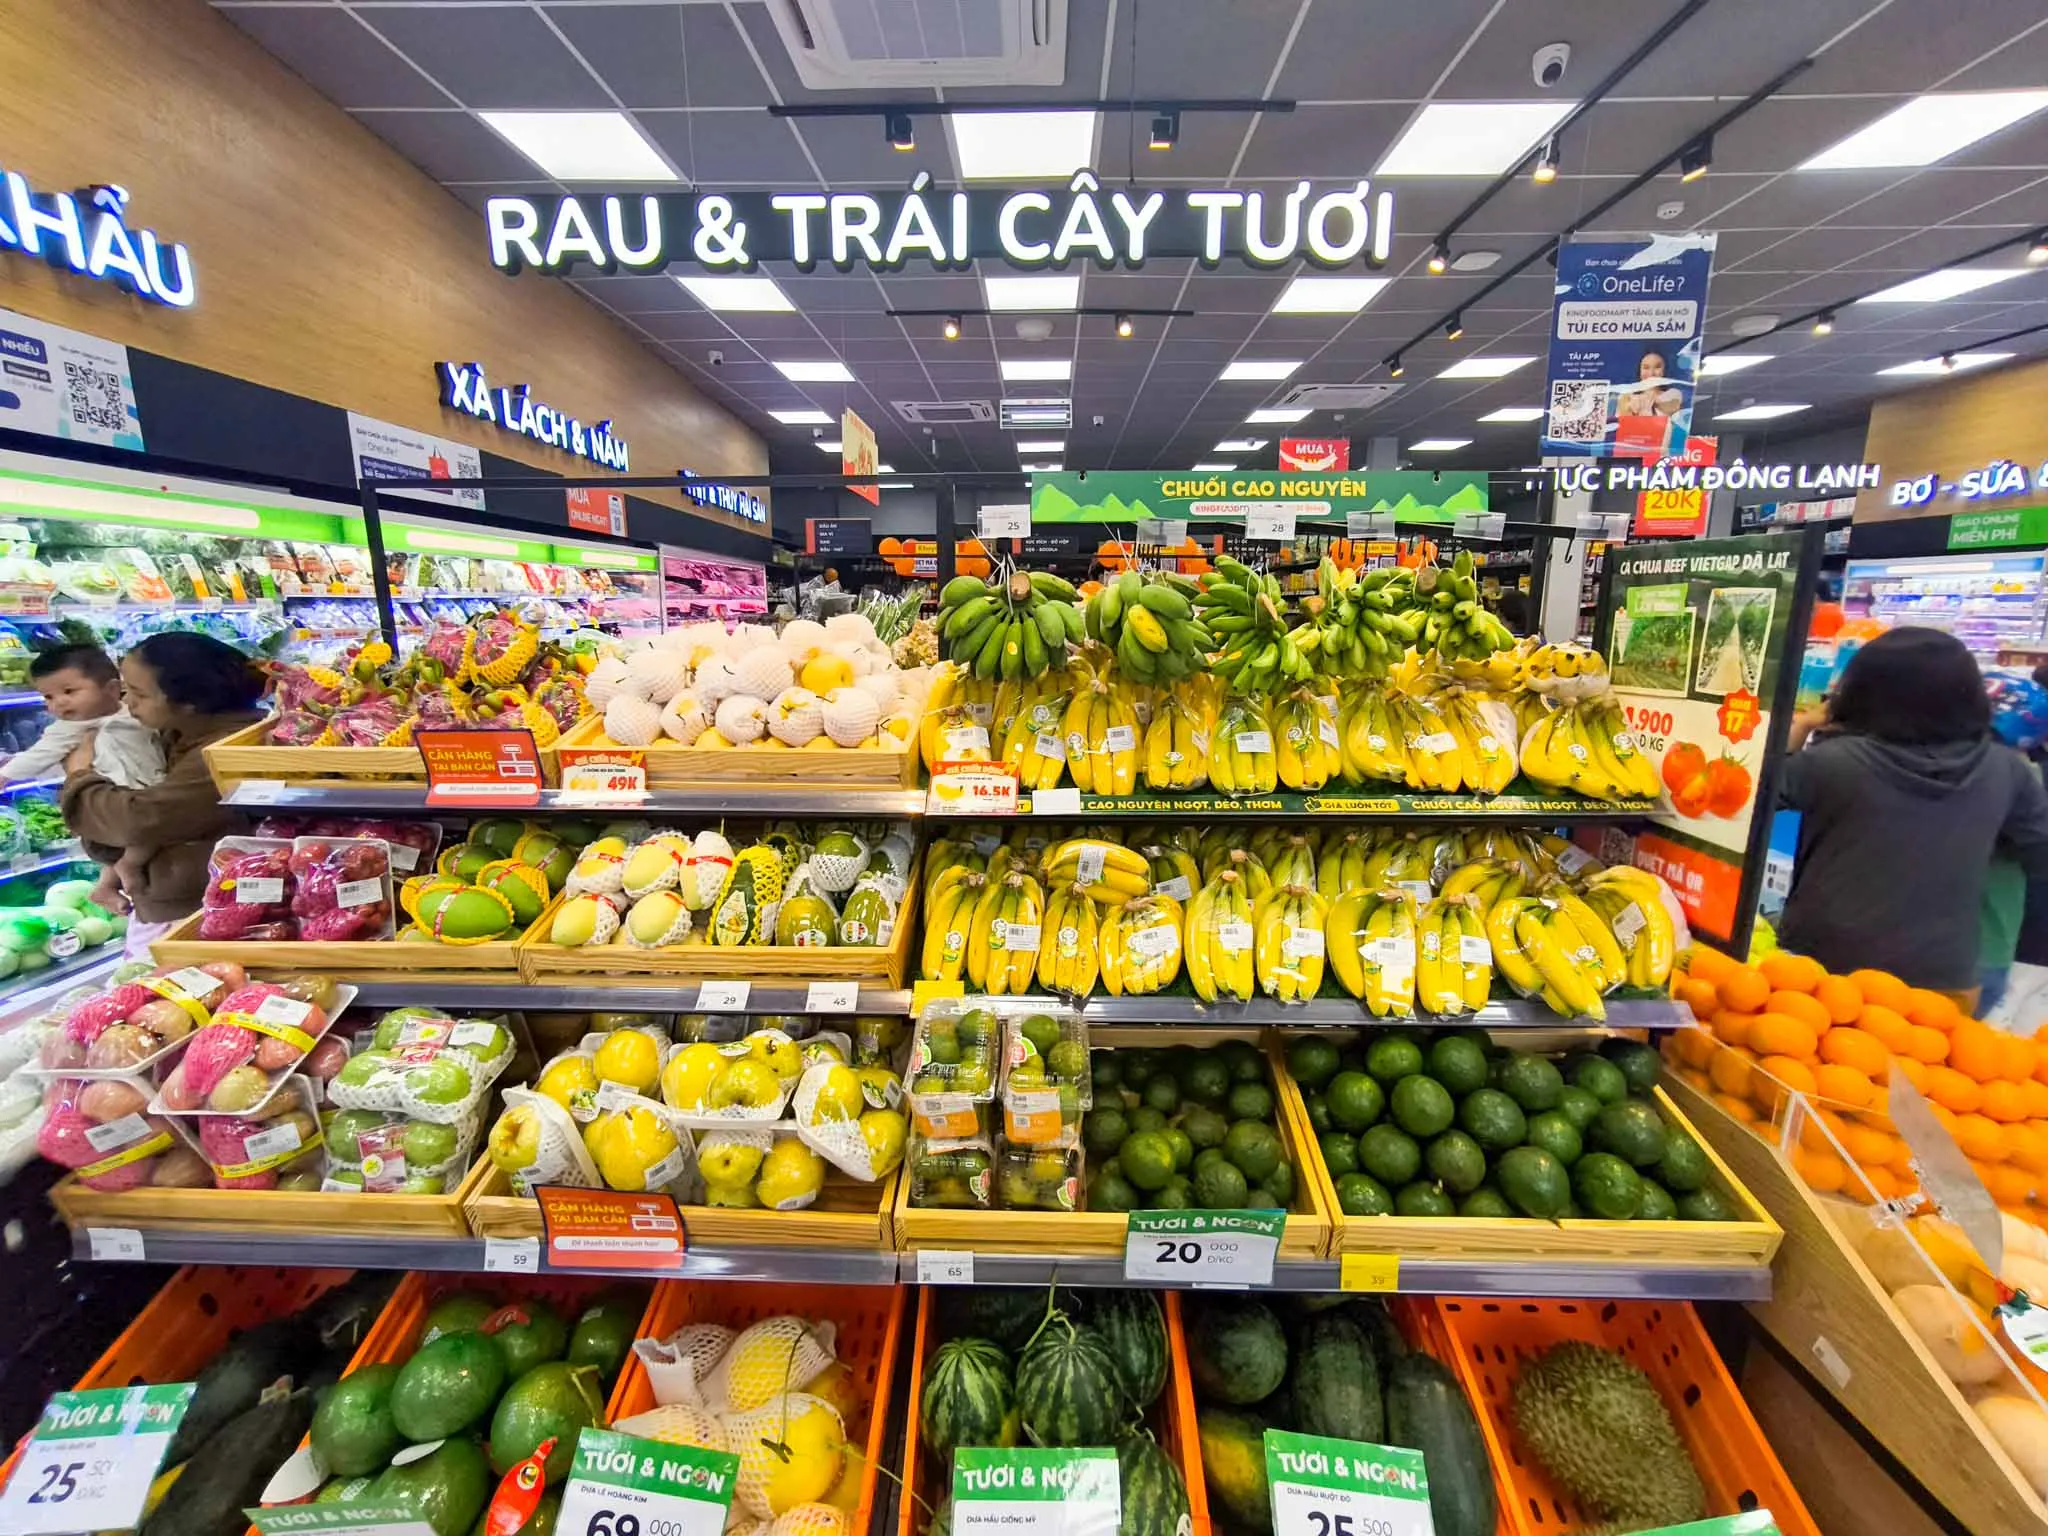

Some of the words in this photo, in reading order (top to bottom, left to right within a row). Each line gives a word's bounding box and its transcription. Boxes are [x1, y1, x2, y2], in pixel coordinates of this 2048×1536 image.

[487, 195, 663, 268] RAU
[693, 195, 749, 266] &
[771, 170, 968, 264] TRÁI
[999, 172, 1164, 262] CÂY
[1187, 180, 1393, 263] TƯƠI
[0, 171, 195, 306] HẨU
[1602, 275, 1686, 294] OneLife?
[1567, 318, 1589, 334] TÚI
[1591, 321, 1619, 334] ECO
[1622, 321, 1653, 334] MUA
[1655, 316, 1686, 334] SẮM
[447, 361, 497, 422] XÀ
[501, 384, 568, 450] LÁCH
[571, 419, 588, 456] &
[589, 419, 630, 473] NẤM
[1295, 443, 1325, 455] MUA
[1608, 456, 1697, 491] PHẨM
[1700, 458, 1792, 490] ĐÔNG
[1798, 463, 1881, 495] LẠNH
[1891, 473, 1935, 506] BƠ
[1959, 459, 2026, 498] SỮA
[1160, 475, 1228, 497] CHUỐI
[1231, 480, 1276, 498] CAO
[1280, 477, 1367, 498] NGUYÊN
[1650, 488, 1696, 510] 20K
[1007, 521, 1020, 531] 25
[1271, 523, 1284, 533] 28
[1632, 559, 1662, 575] CHUA
[1663, 557, 1688, 573] BEEF
[1689, 553, 1740, 572] VIETGAP
[1649, 736, 1664, 752] KG
[607, 775, 639, 791] 49K
[972, 784, 1011, 797] 16.5K
[1087, 800, 1115, 810] CAO
[1117, 799, 1171, 810] NGUYÊN
[1243, 800, 1283, 809] THƠM
[1411, 799, 1454, 810] CHUỐI
[1455, 800, 1483, 810] CAO
[722, 996, 737, 1005] 29
[832, 997, 847, 1006] 45
[1136, 1216, 1187, 1231] TƯƠI
[1192, 1216, 1206, 1229] &
[512, 1254, 528, 1265] 59
[1155, 1241, 1202, 1264] 20
[1209, 1243, 1239, 1252] 000
[947, 1267, 962, 1277] 65
[49, 1402, 100, 1431] TƯƠI
[98, 1404, 115, 1424] &
[583, 1449, 637, 1474] TƯƠI
[639, 1456, 656, 1478] &
[1276, 1450, 1330, 1475] TƯƠI
[1334, 1456, 1350, 1478] &
[27, 1461, 86, 1504] 25
[962, 1463, 1016, 1491] TƯƠI
[1020, 1466, 1036, 1487] &
[1041, 1465, 1074, 1489] NG
[261, 1510, 319, 1529] TƯƠI
[322, 1509, 340, 1523] &
[586, 1508, 641, 1536] 69
[1307, 1510, 1354, 1536] 25
[1362, 1518, 1393, 1536] 500
